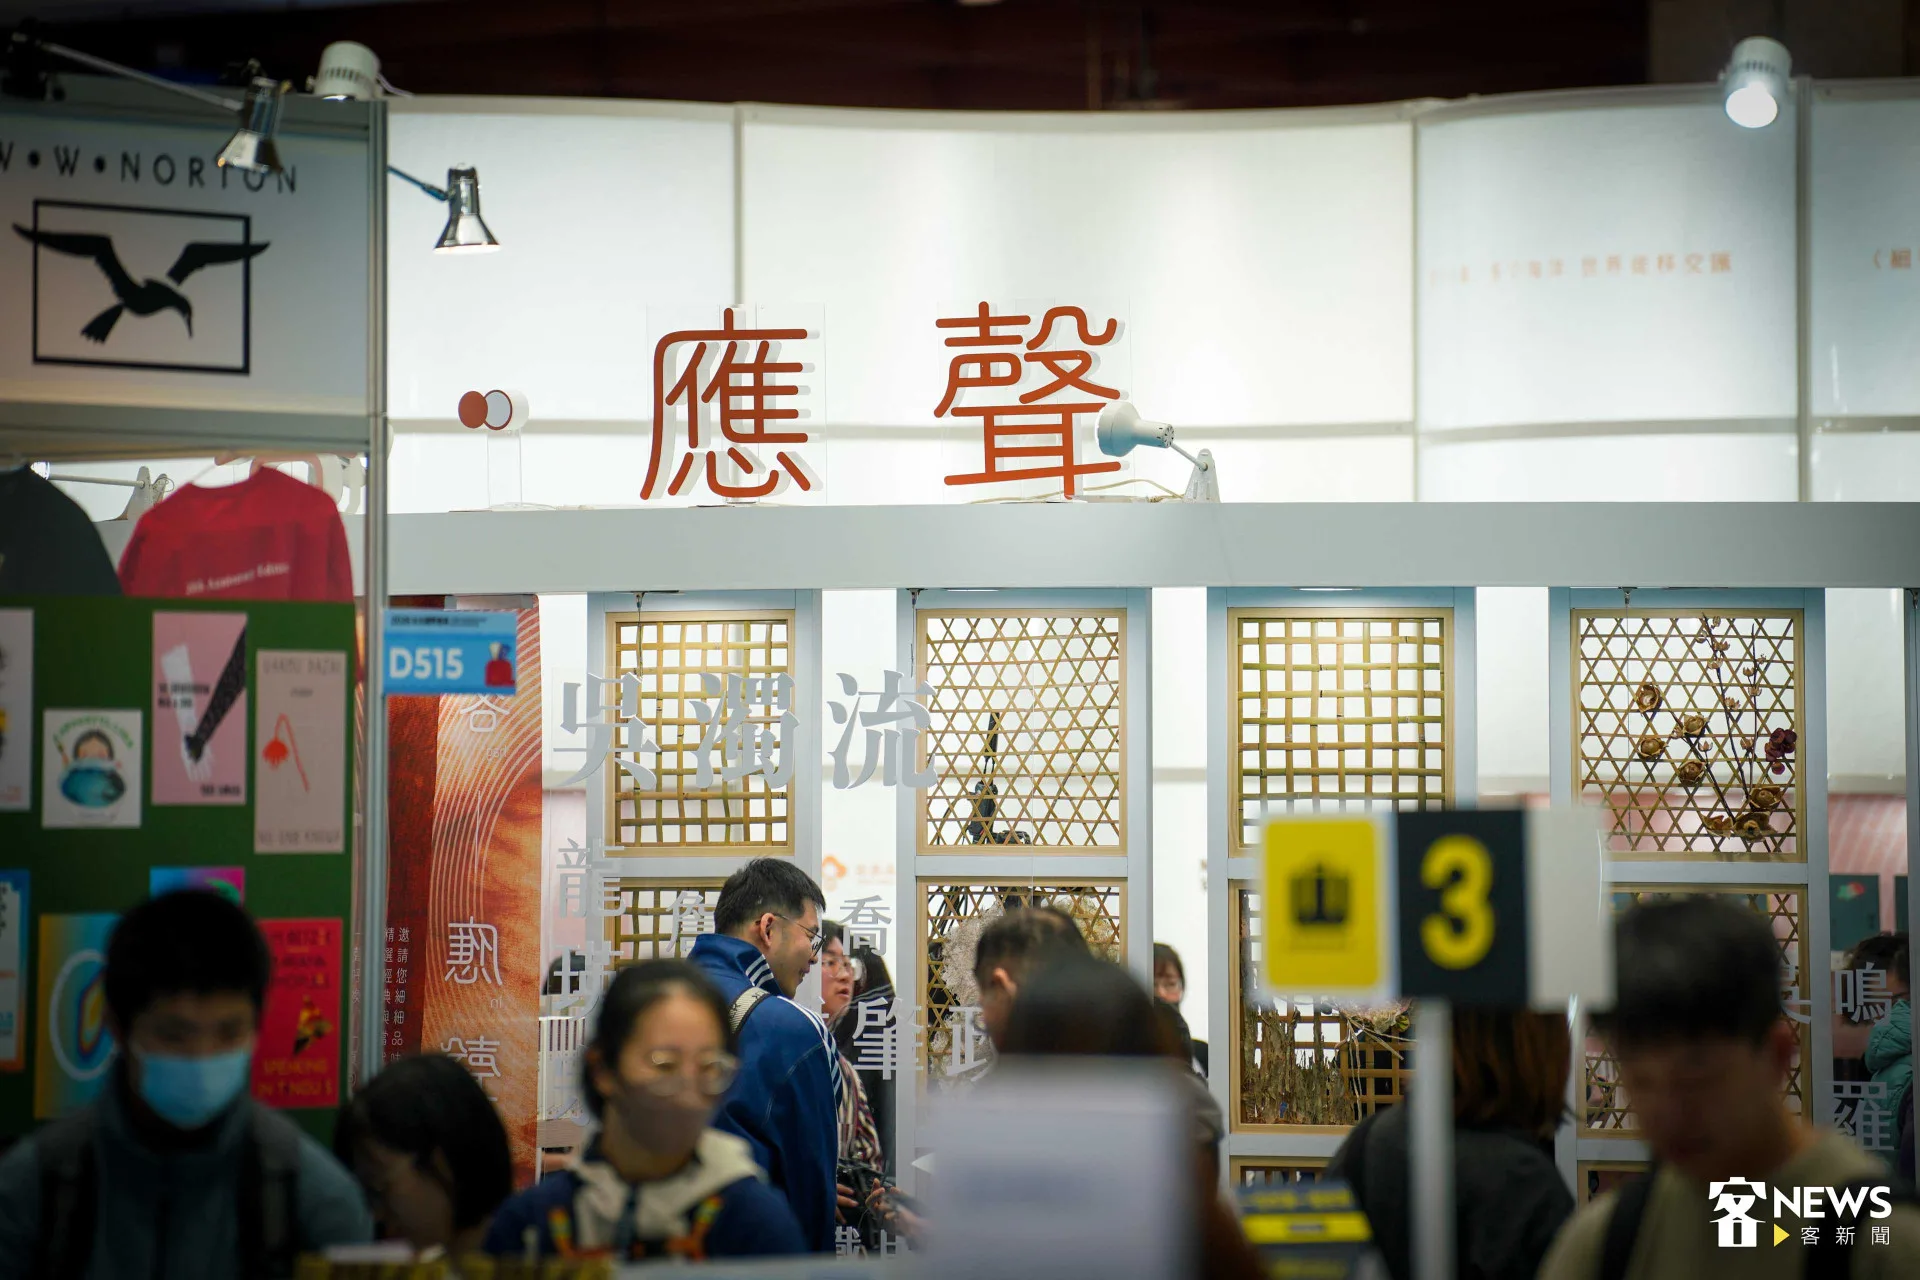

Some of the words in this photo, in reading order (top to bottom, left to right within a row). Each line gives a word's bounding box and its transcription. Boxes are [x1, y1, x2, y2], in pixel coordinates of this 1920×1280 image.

[389, 647, 465, 681] D515
[553, 669, 939, 791] 吳濁流
[839, 894, 892, 956] 喬
[1419, 834, 1496, 970] 3
